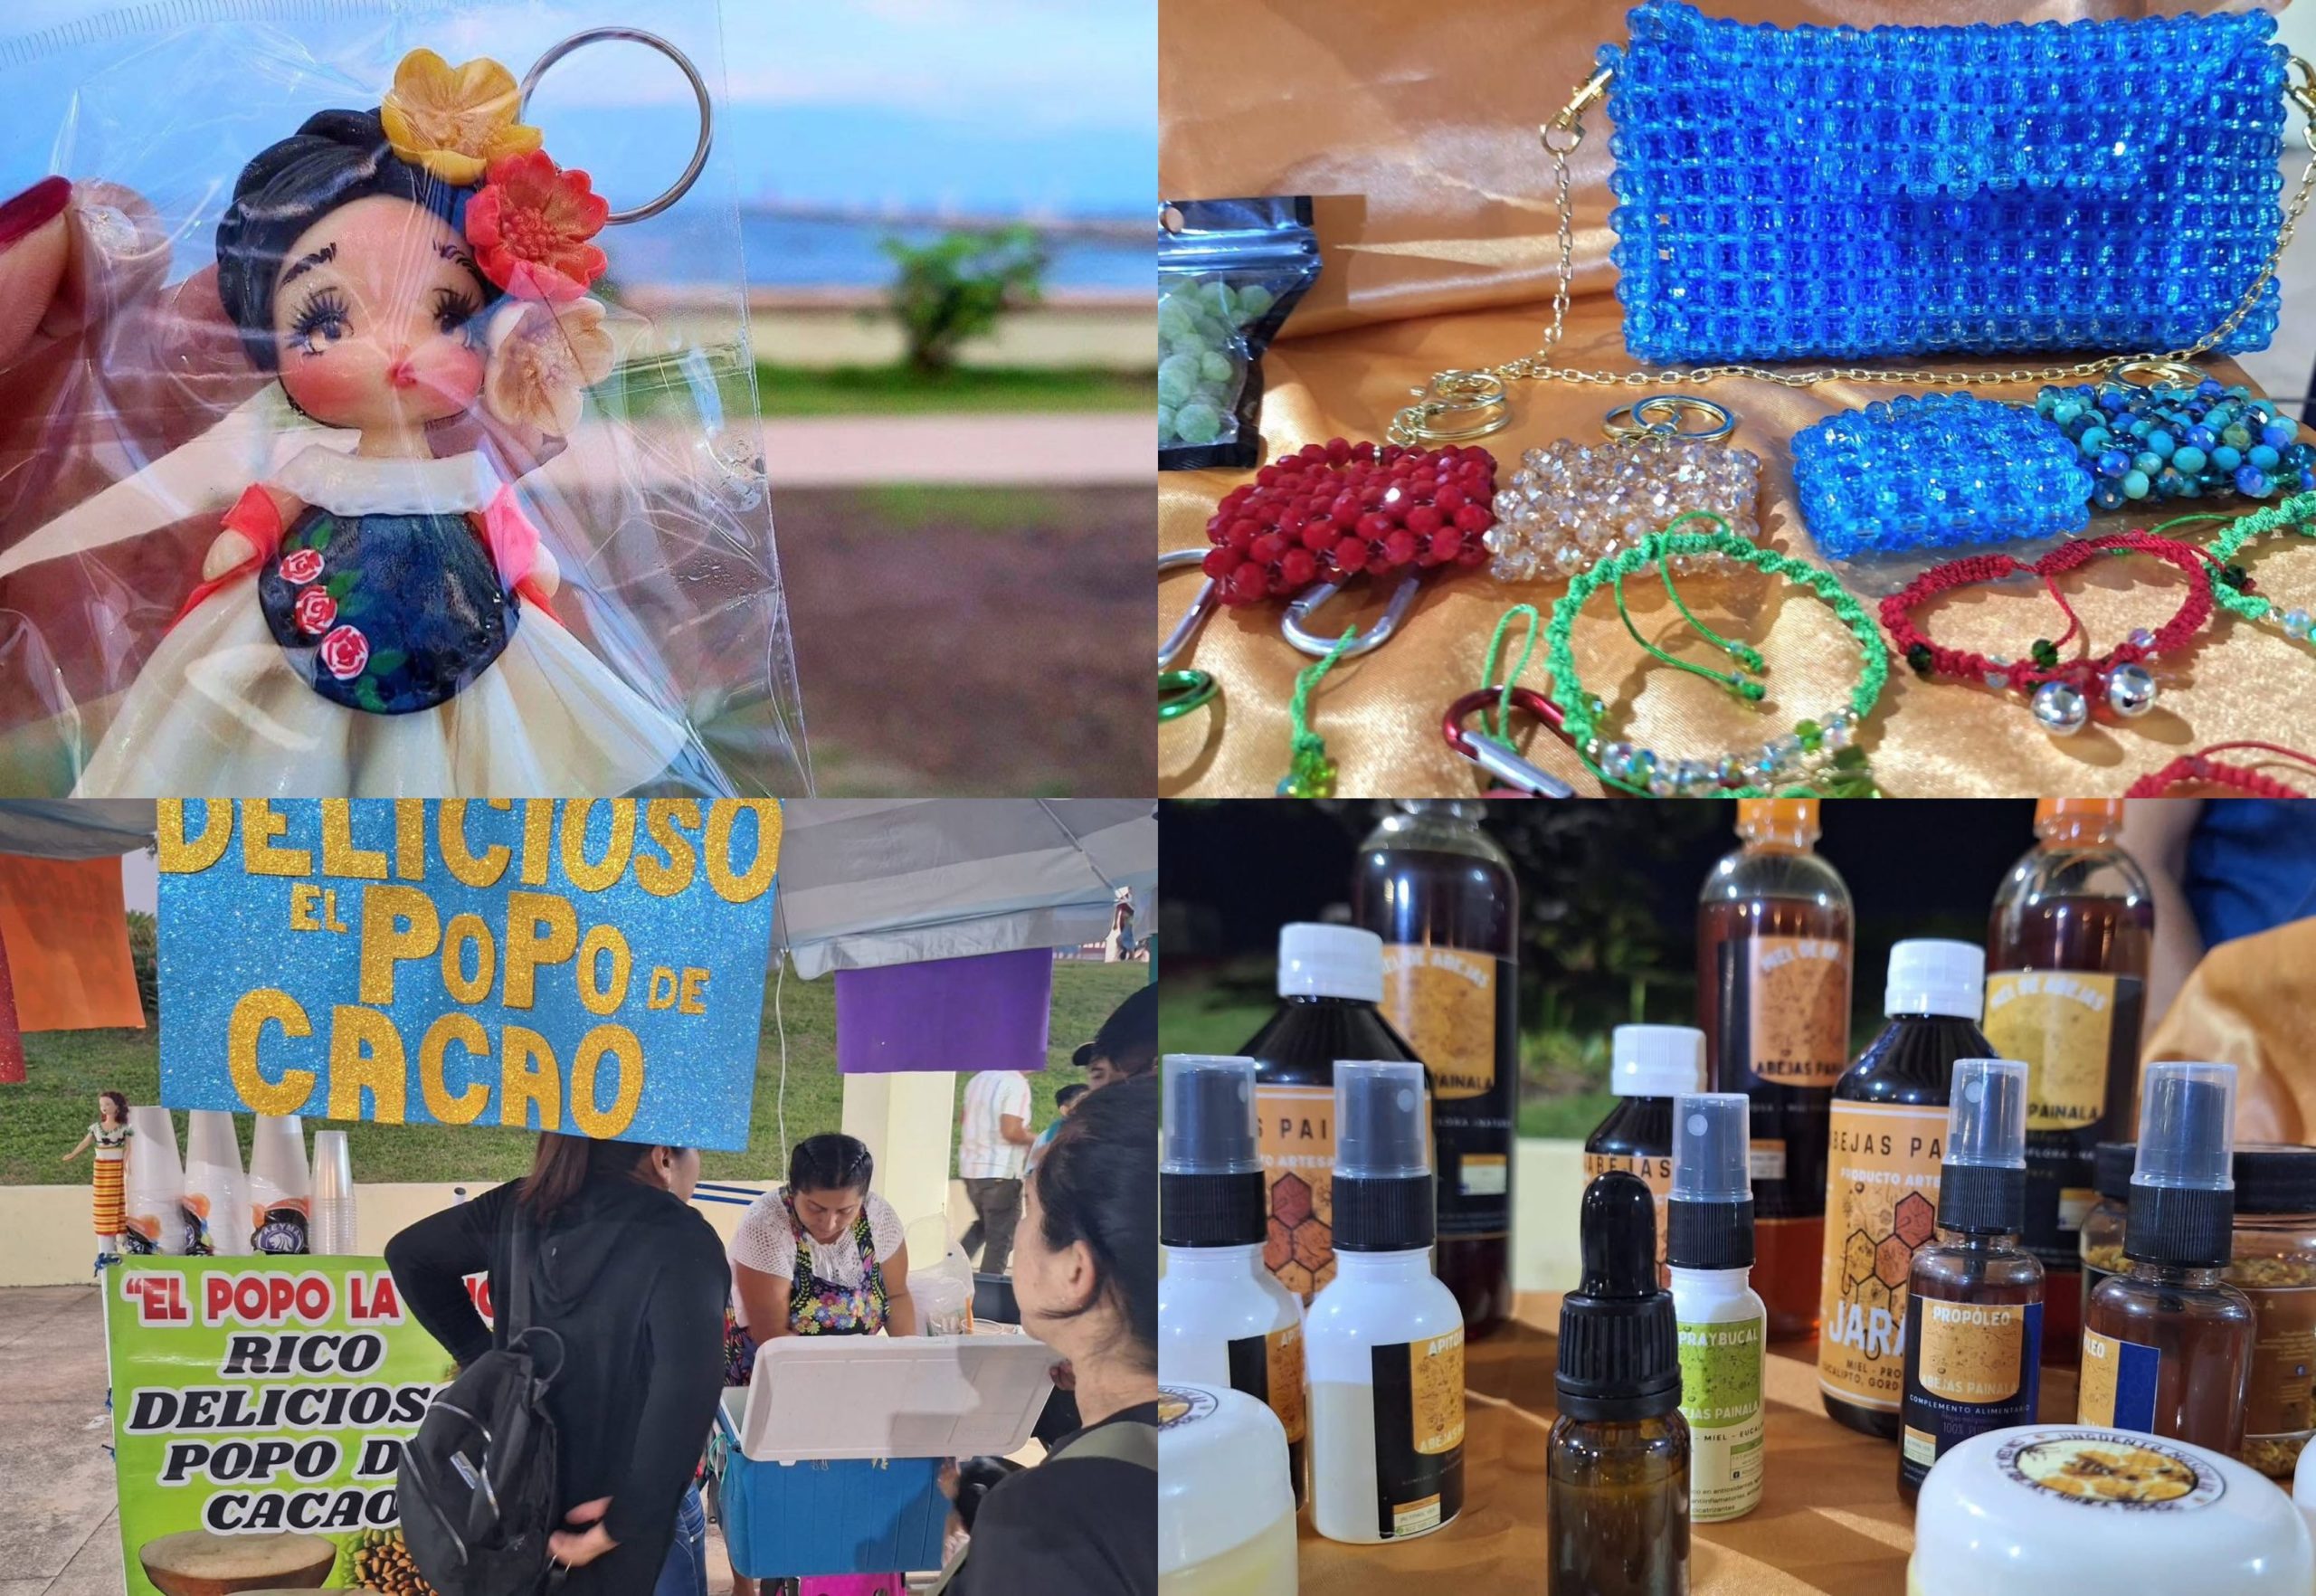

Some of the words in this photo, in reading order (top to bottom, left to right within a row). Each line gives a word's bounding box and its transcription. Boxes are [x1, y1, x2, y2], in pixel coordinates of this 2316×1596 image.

[157, 798, 783, 903] DELICIOSO
[290, 883, 347, 933] EL
[358, 885, 632, 1015] POPO
[648, 966, 710, 1014] DE
[228, 988, 644, 1139] CACAO
[2026, 1103, 2099, 1120] PAINALA
[207, 1277, 330, 1320] POPO
[351, 1277, 400, 1319] LA
[1932, 1306, 2012, 1326] PROPÓLEO
[223, 1334, 382, 1373] RICO
[1679, 1326, 1759, 1347] PRAYBUCAL
[1909, 1393, 1971, 1414] COMPLEMENTO
[1922, 1373, 1963, 1394] ABEJAS
[1966, 1381, 2019, 1397] PAINALA
[128, 1387, 434, 1430] DELICIOS
[1714, 1400, 1760, 1420] PAINALA
[162, 1442, 336, 1482] POPO
[206, 1489, 400, 1530] CACAO
